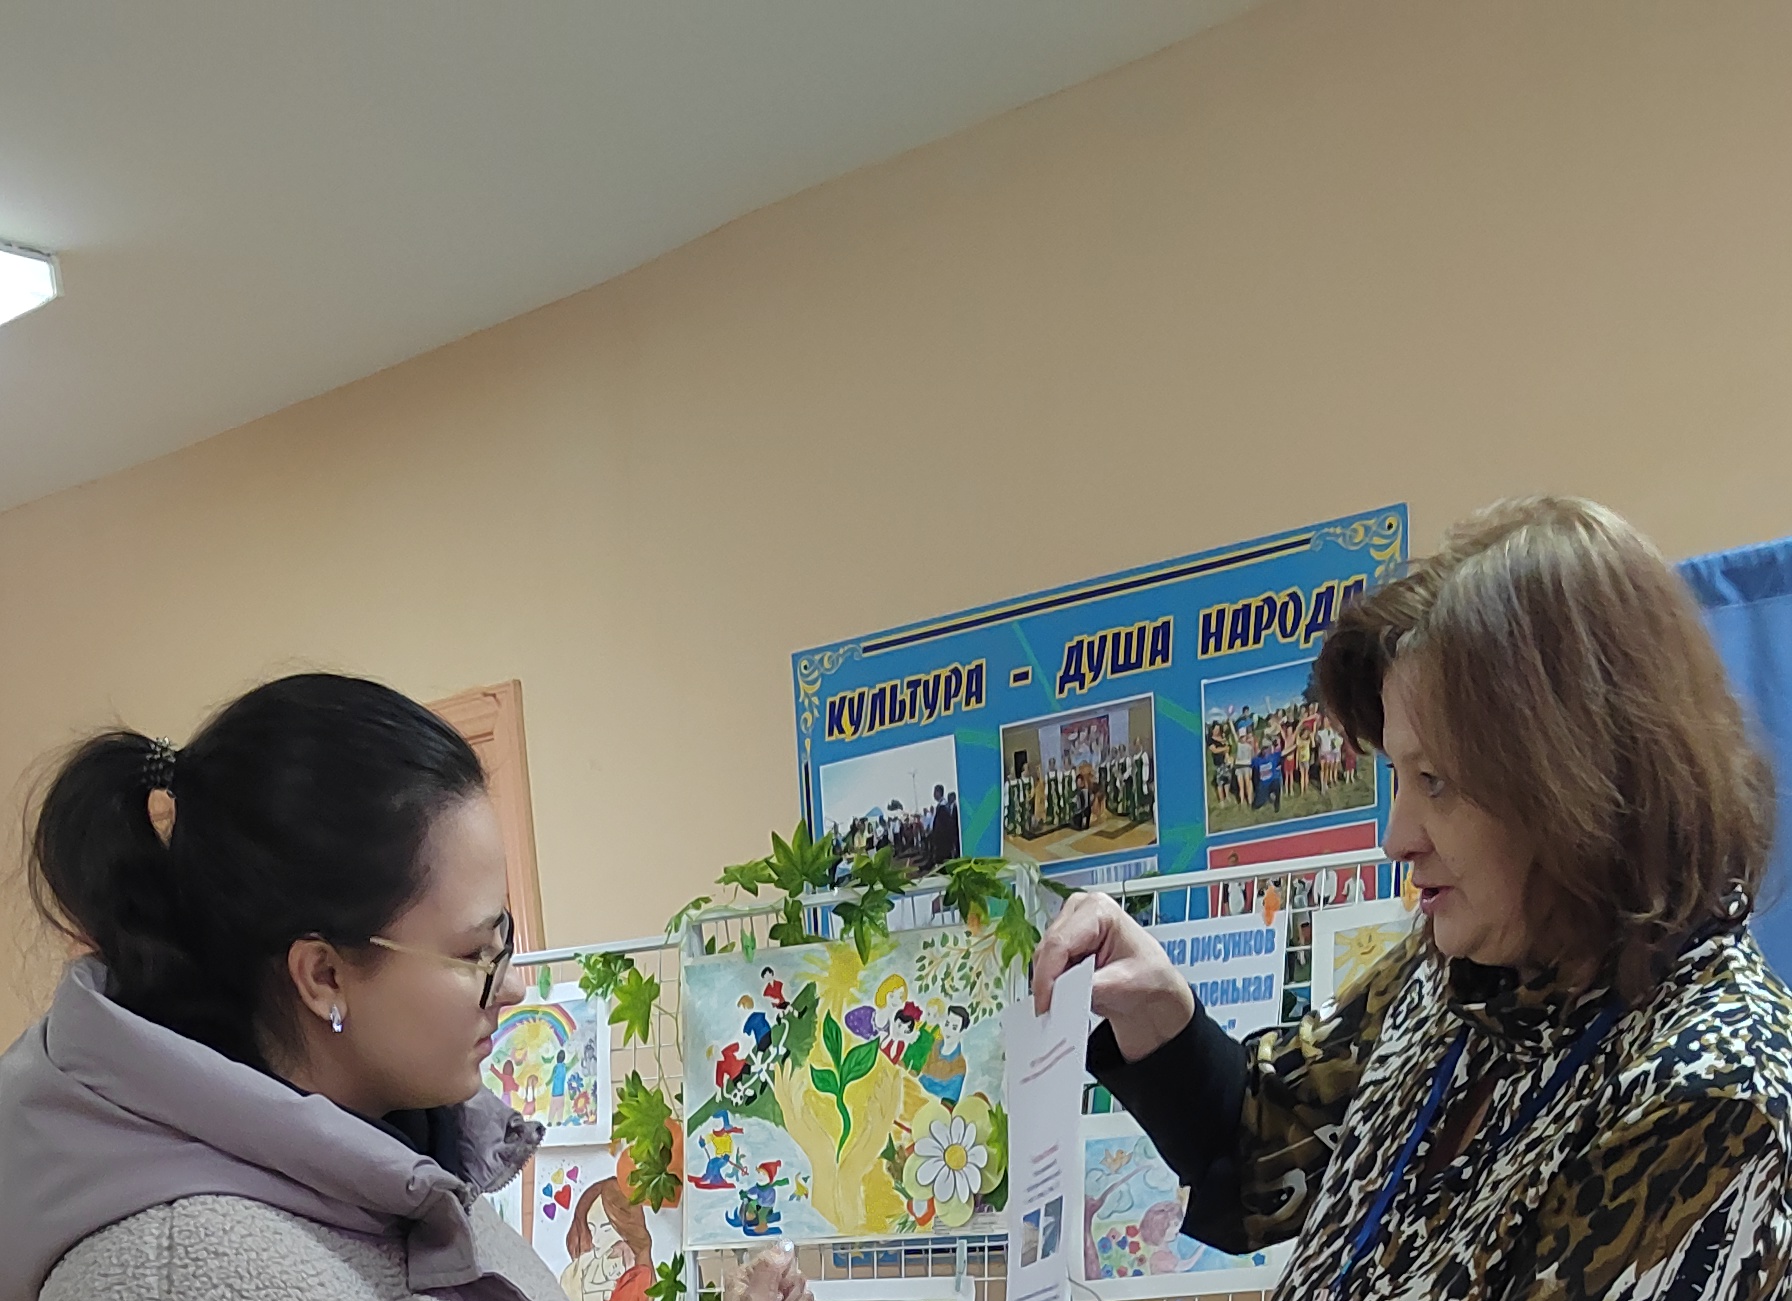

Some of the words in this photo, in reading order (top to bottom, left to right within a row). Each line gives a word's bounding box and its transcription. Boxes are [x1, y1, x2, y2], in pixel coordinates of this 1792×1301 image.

[826, 659, 986, 741] КУЛЬТУРА
[1056, 616, 1174, 699] ДУША
[1189, 928, 1276, 967] рисунков
